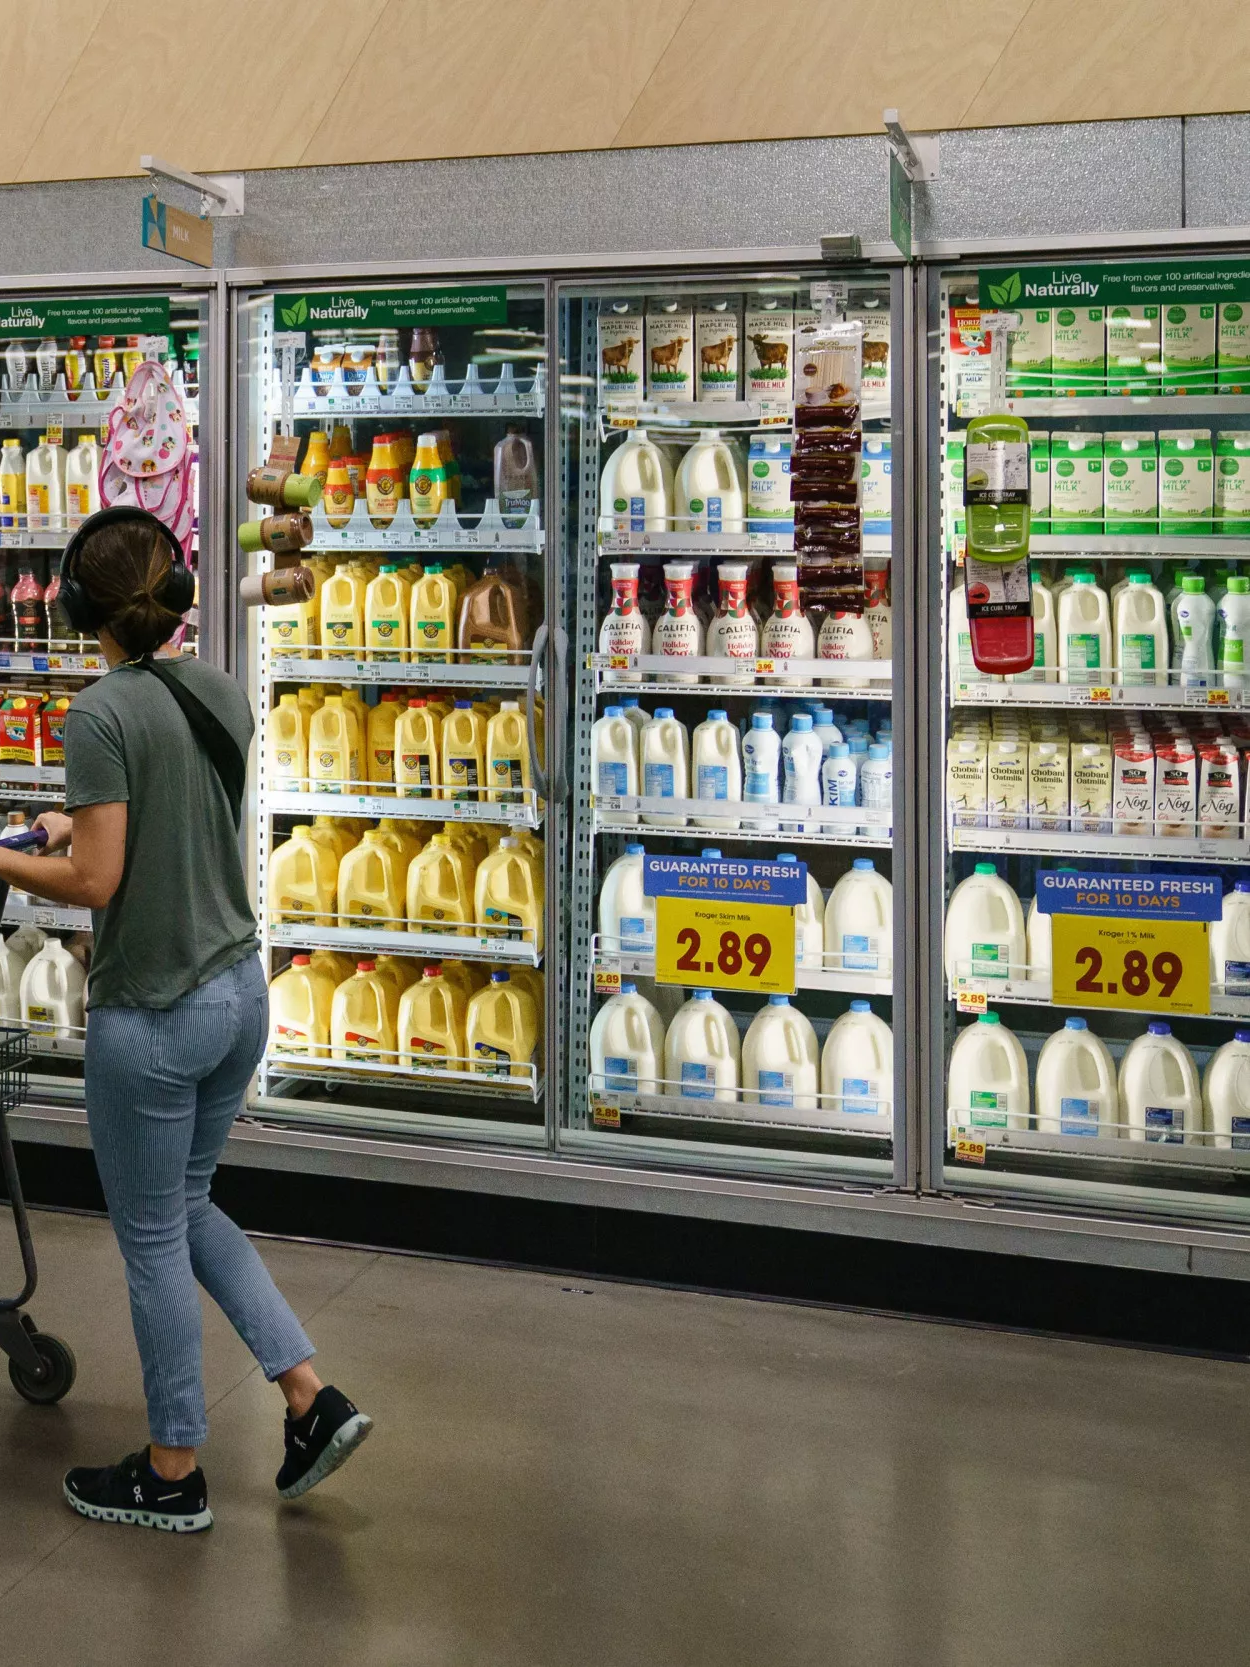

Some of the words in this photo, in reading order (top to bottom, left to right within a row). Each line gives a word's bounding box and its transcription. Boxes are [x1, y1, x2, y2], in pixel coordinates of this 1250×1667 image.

[172, 225, 190, 242] MILK
[1052, 271, 1082, 285] Live
[1102, 274, 1121, 283] Free
[1122, 273, 1142, 283] from
[1143, 274, 1162, 282] over
[1165, 272, 1181, 281] 100
[1182, 271, 1215, 281] artificial
[1216, 269, 1250, 282] ingredie
[1024, 281, 1100, 298] Naturally
[1130, 283, 1159, 293] flavors
[1159, 283, 1177, 292] and
[1177, 281, 1236, 293] preservatives.
[331, 296, 355, 308] Live
[371, 299, 386, 307] Free
[387, 299, 403, 307] from
[420, 297, 434, 305] 100
[434, 296, 460, 305] artificial
[460, 295, 500, 306] ingredients,
[11, 306, 33, 318] Live
[47, 309, 60, 317] Free
[91, 308, 104, 316] 100
[104, 307, 126, 315] artificial
[126, 306, 164, 317] ingredients,
[309, 305, 369, 320] Naturally
[393, 307, 415, 316] flavors
[416, 307, 430, 315] and
[431, 305, 477, 316] preservatives.
[67, 317, 86, 325] flavors
[101, 316, 143, 325] preservatives.
[1110, 332, 1134, 340] MILK
[1165, 331, 1190, 339] MILK
[1221, 329, 1245, 337] MILK
[103, 357, 111, 389] Nesquik
[751, 381, 771, 389] WHOLE
[772, 381, 786, 389] MILK
[612, 419, 635, 427] 6.59
[751, 484, 773, 492] MILK
[604, 622, 642, 632] CALIFIA
[657, 624, 697, 633] CALIFIA
[718, 625, 757, 635] CALIFIA
[763, 625, 801, 634] CALIFIA
[609, 639, 635, 647] Holiday
[661, 641, 690, 649] Holiday
[727, 643, 754, 651] Holiday
[767, 641, 793, 650] Holiday
[1092, 691, 1109, 699] 3.99
[1210, 692, 1227, 701] 3.99
[3, 715, 29, 724] HORIZON
[950, 765, 985, 774] Chobani
[990, 767, 1025, 776] Chobani
[1030, 769, 1066, 777] Chobani
[1073, 770, 1109, 779] Chobani
[952, 772, 983, 781] Oatmilk
[992, 774, 1023, 782] Oatmilk
[1032, 776, 1064, 784] Oatmilk
[1075, 777, 1107, 786] Oatmilk
[1116, 795, 1152, 812] Nog
[1157, 797, 1194, 813] Nog
[1200, 799, 1237, 815] Nog
[649, 860, 748, 877] GUARANTEED
[752, 865, 801, 879] FRESH
[678, 875, 708, 888] FOR
[713, 877, 729, 889] 10
[732, 878, 771, 891] DAYS
[1042, 876, 1155, 892] GUARANTEED
[1160, 880, 1214, 894] FRESH
[1076, 892, 1110, 905] FOR
[1115, 893, 1133, 906] 10
[1137, 895, 1181, 908] DAYS
[694, 911, 718, 920] Kroger
[719, 912, 736, 921] Skim
[736, 913, 751, 921] Milk
[1098, 929, 1124, 940] Kroger
[1126, 930, 1138, 938] 1%
[1138, 931, 1156, 940] Milk
[676, 927, 772, 978] 2.89
[1075, 946, 1183, 998] 2.89
[596, 974, 620, 984] 2.89
[959, 992, 985, 1005] 2.89
[595, 1108, 619, 1119] 2.89
[958, 1142, 984, 1154] 2.89
